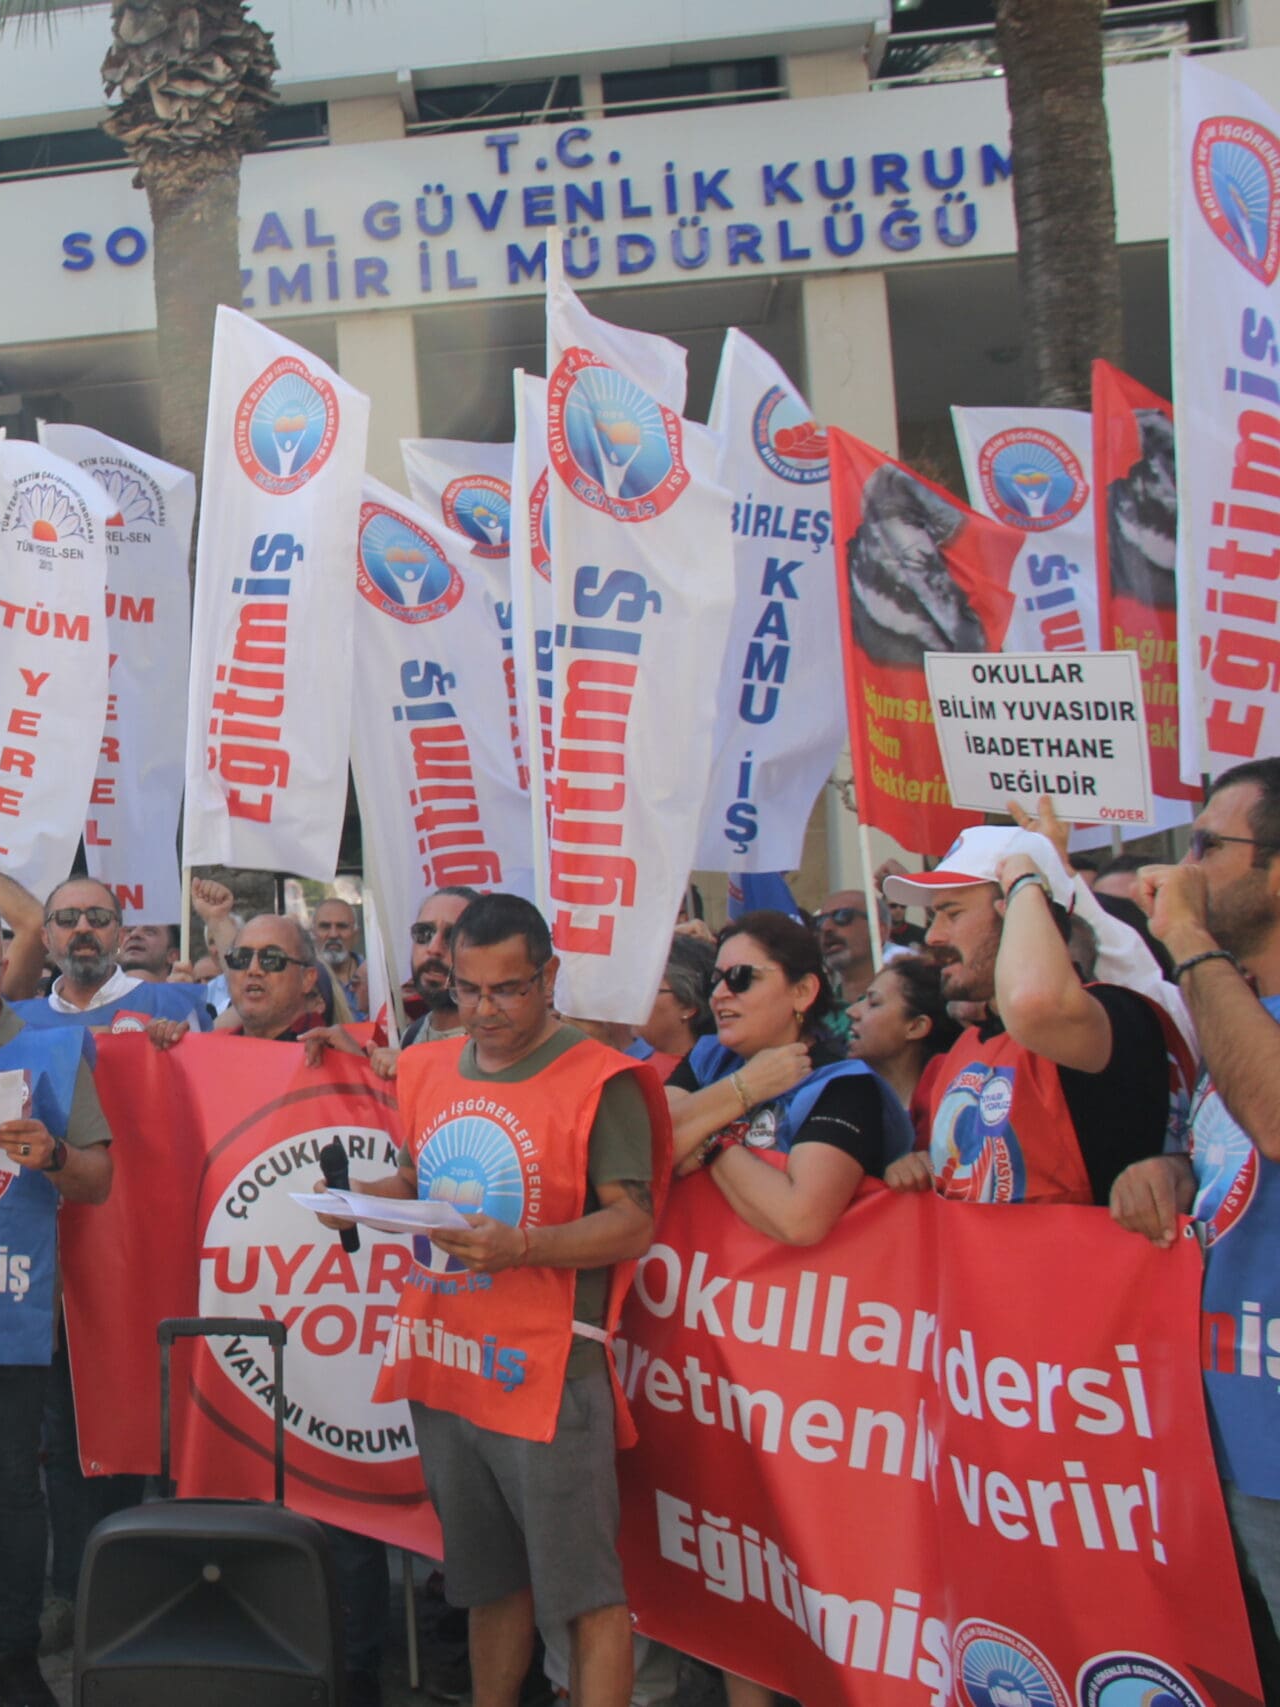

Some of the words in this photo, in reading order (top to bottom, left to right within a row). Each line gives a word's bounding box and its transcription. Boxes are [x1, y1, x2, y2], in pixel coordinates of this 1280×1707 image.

[485, 127, 621, 175] T.C.
[62, 208, 336, 272] SOAL
[363, 160, 734, 241] GÜVENLİK
[763, 143, 1013, 206] KURUM
[419, 241, 477, 292] İL
[507, 193, 977, 283] MÜDÜRLÜĞÜ
[106, 530, 151, 544] REL-SEN
[208, 533, 304, 823] Eğitimiş
[739, 556, 804, 725] KAMU
[972, 663, 1084, 684] OKULLAR
[938, 695, 996, 720] BİLİM
[1004, 700, 1137, 721] YUVASIDIR
[964, 730, 1114, 759] İBADETHANE
[392, 659, 502, 895] ğitimiş
[549, 566, 662, 956] Eğitimiş
[724, 751, 758, 854] İŞ
[989, 770, 1097, 796] DEĞİLDİR
[1099, 805, 1144, 820] ÖVDER
[451, 1096, 538, 1158] İŞGÖRENLERİ
[226, 1134, 376, 1219] ÇOCUKLRI
[213, 1243, 415, 1296] UYAR
[634, 1243, 937, 1373] Okullar
[945, 1329, 1152, 1440] dersi
[307, 1416, 412, 1453] KORUM
[950, 1453, 1167, 1566] verir!
[656, 1488, 953, 1707] Eğitimiş
